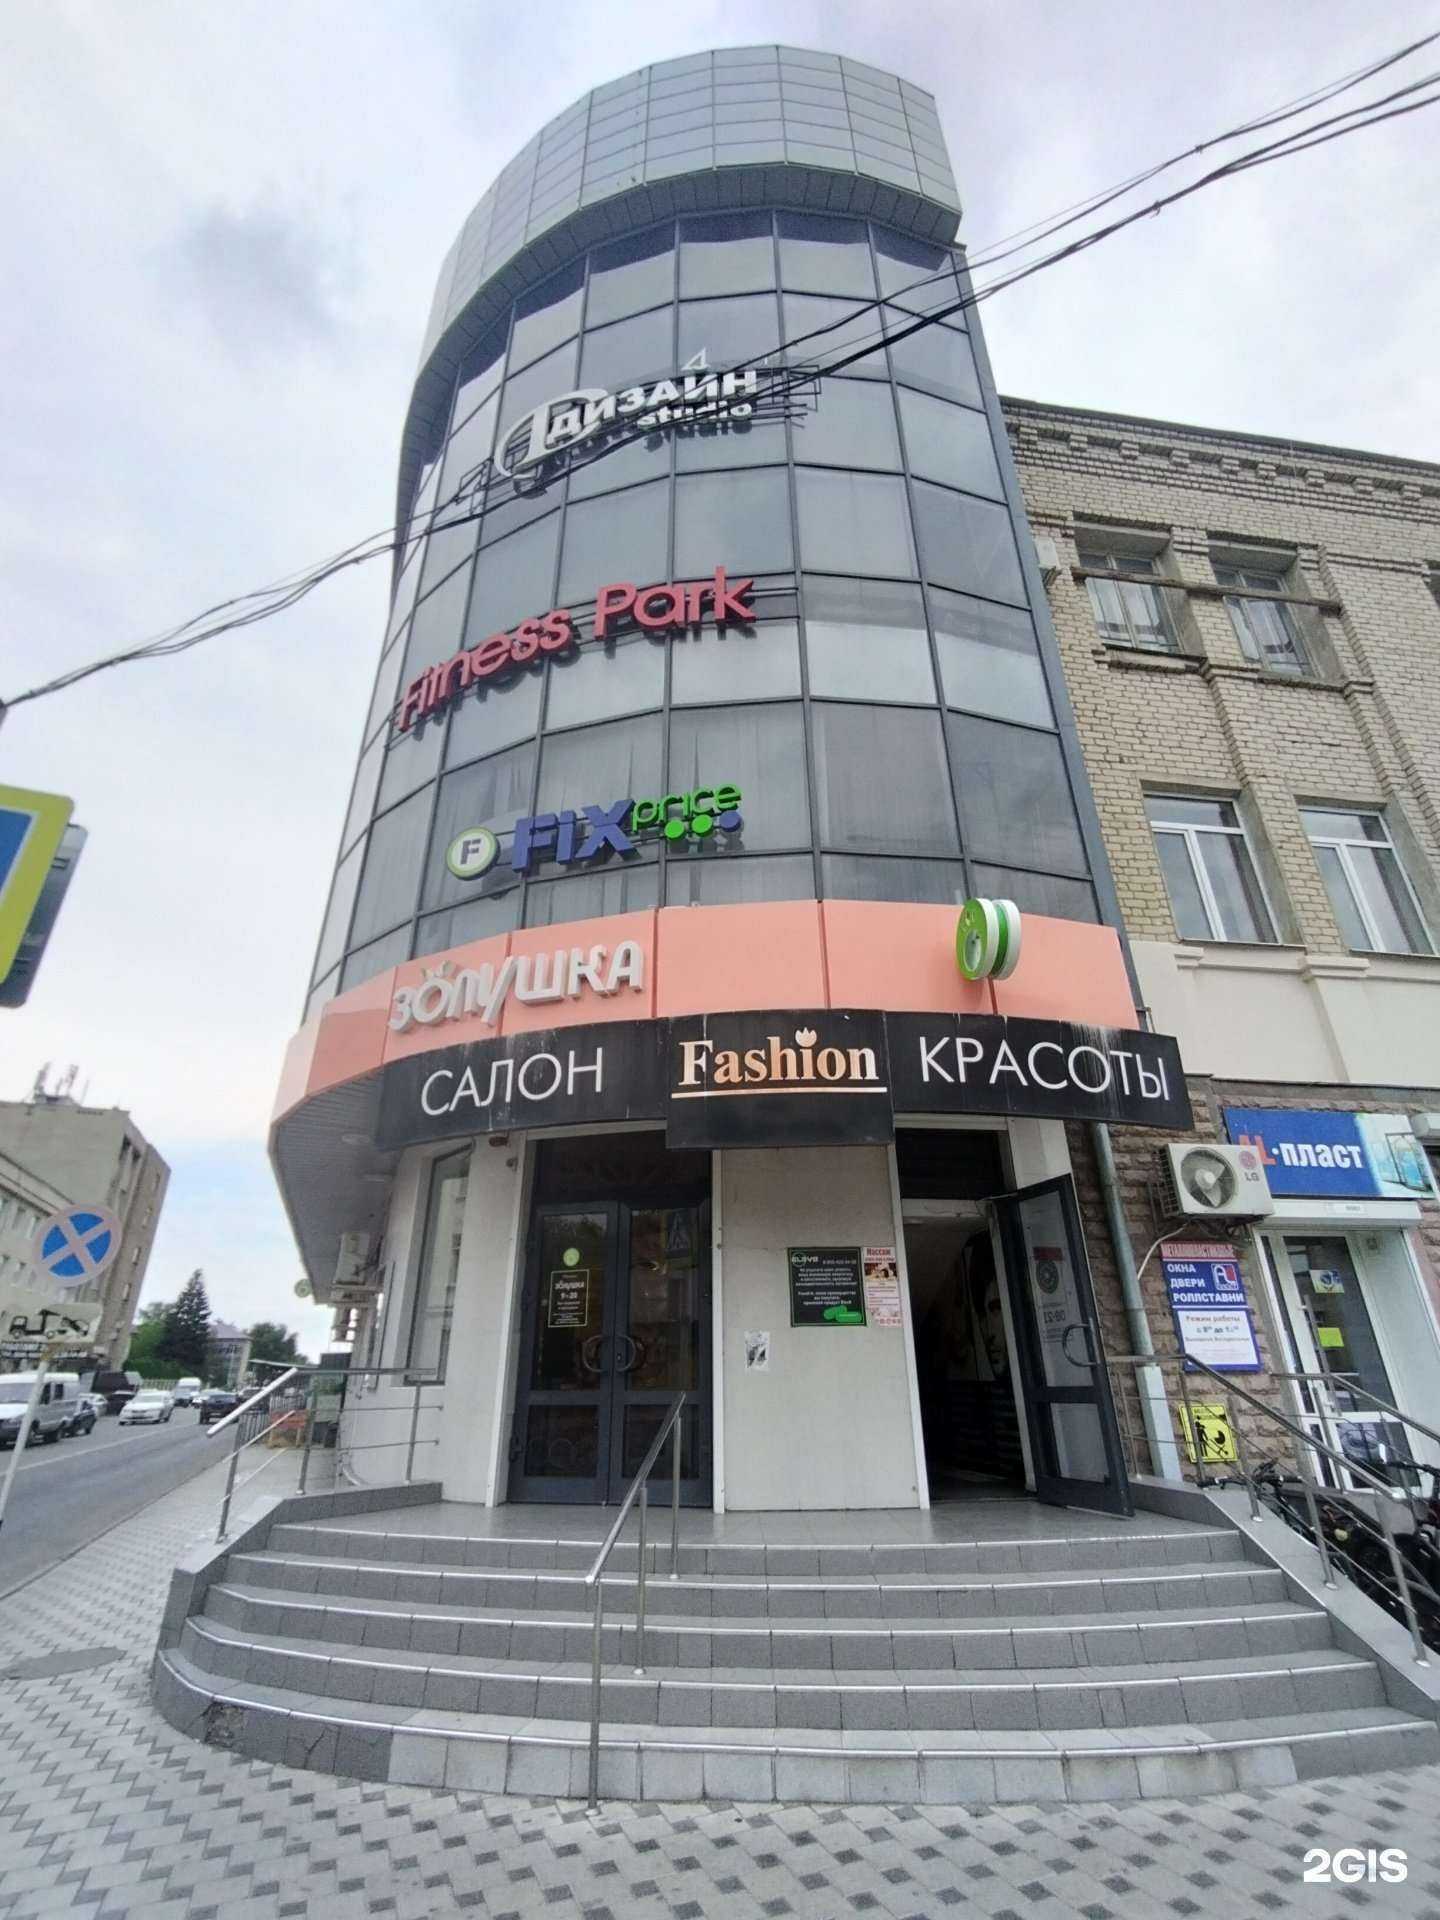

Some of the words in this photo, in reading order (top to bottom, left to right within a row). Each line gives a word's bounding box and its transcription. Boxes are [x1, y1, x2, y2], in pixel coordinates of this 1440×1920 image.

[393, 609, 572, 732] Fitness
[593, 565, 756, 640] Park
[511, 798, 643, 873] FIX
[631, 783, 742, 833] price
[420, 1047, 603, 1116] САЛОН
[678, 1028, 880, 1087] Fashion
[919, 1036, 1170, 1100] КРАСОТЫ
[1166, 1263, 1197, 1273] ОКНА
[1170, 1278, 1206, 1289] ДВЕРИ
